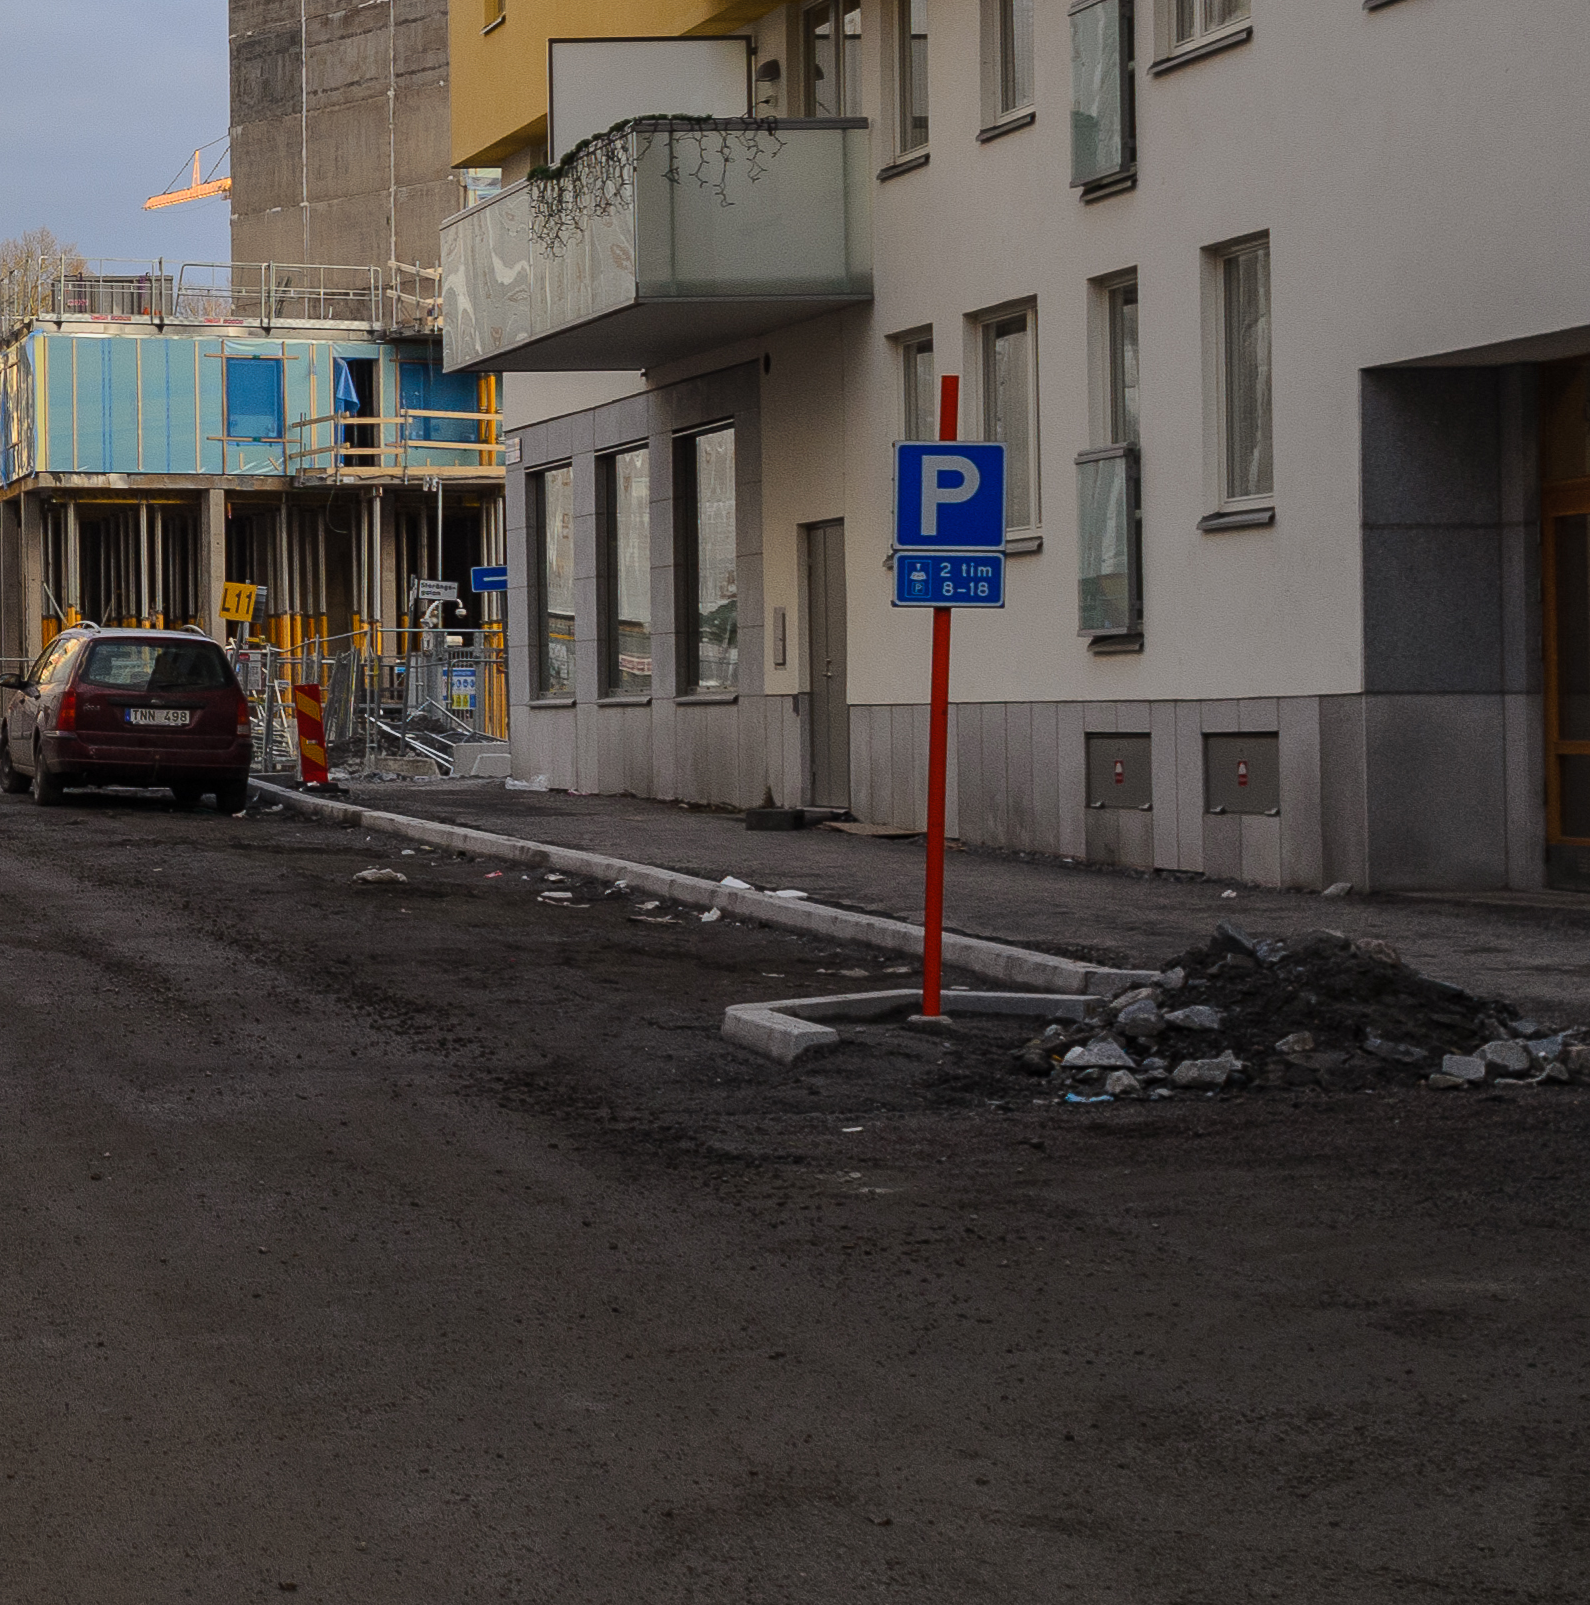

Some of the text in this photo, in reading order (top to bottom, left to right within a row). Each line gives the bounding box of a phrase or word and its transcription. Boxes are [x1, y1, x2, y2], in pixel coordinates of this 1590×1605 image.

[921, 455, 980, 535] P
[940, 562, 992, 577] 2 tim
[942, 581, 989, 596] 8-18
[221, 587, 252, 615] L11
[132, 709, 187, 723] TNN 498
